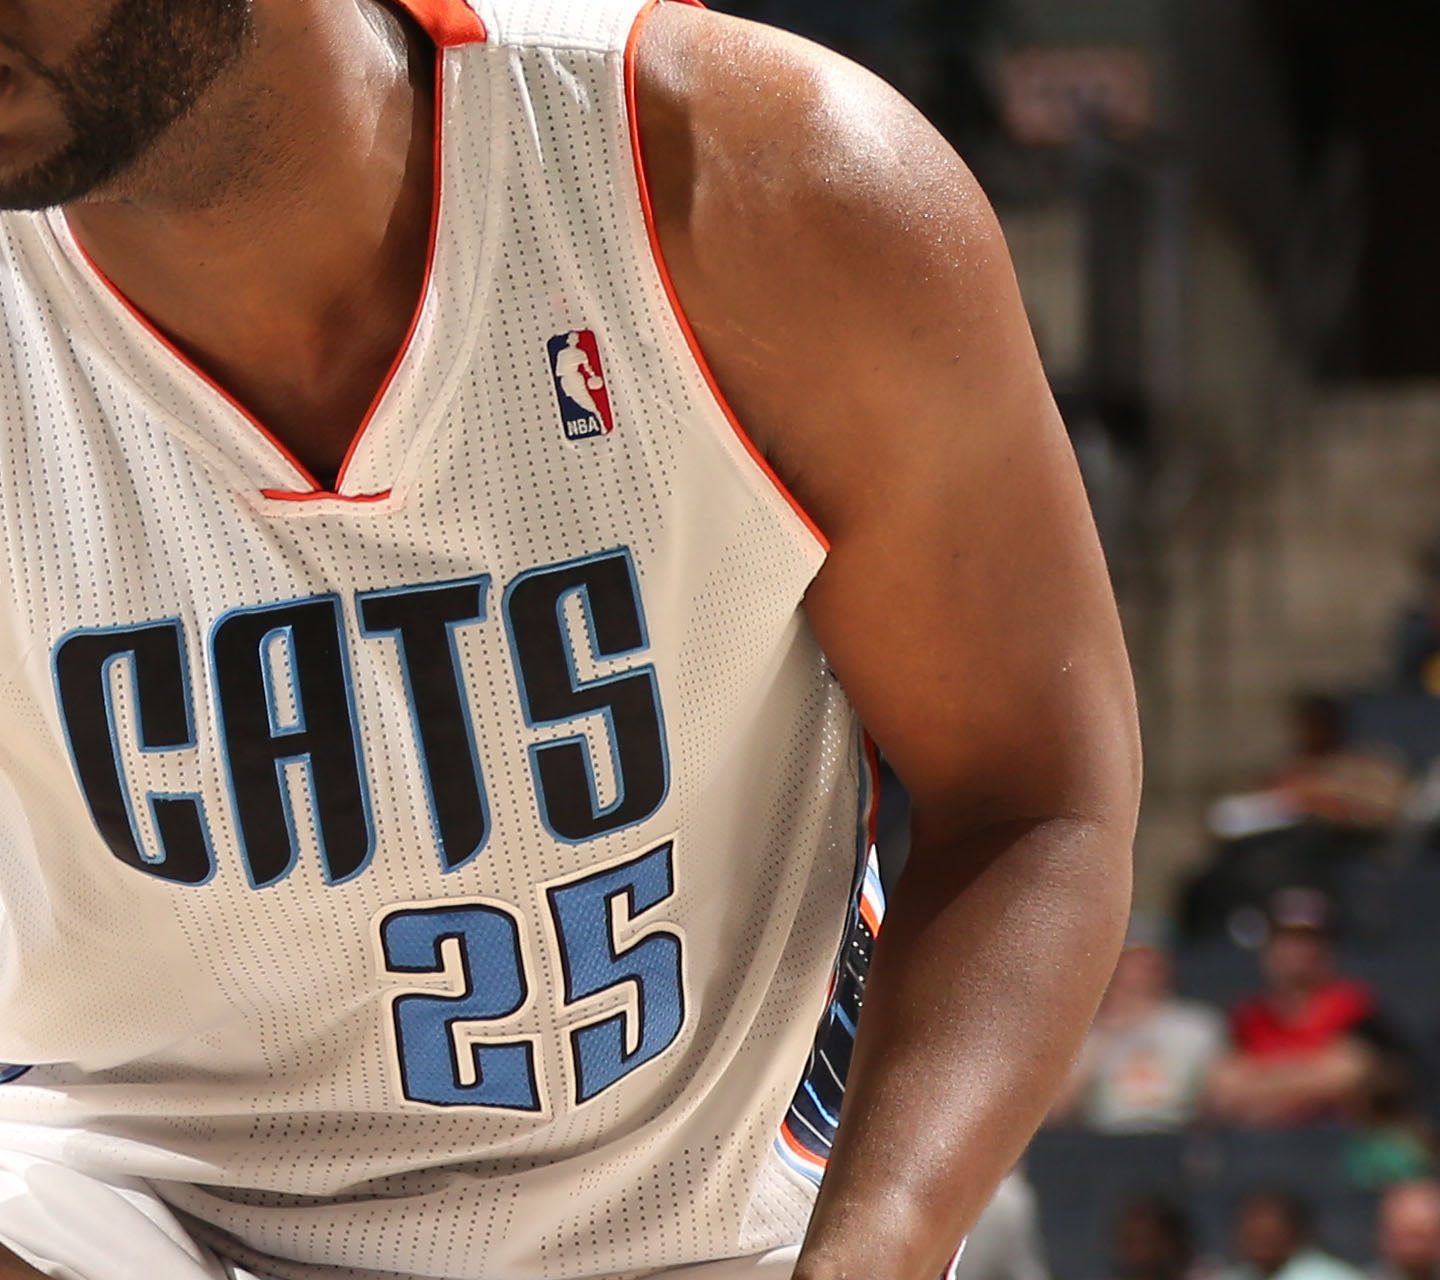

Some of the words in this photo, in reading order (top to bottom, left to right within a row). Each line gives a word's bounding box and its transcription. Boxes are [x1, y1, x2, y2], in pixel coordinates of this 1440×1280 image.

[565, 415, 601, 437] NBA
[51, 546, 673, 890] CATS
[376, 835, 687, 1116] 25
